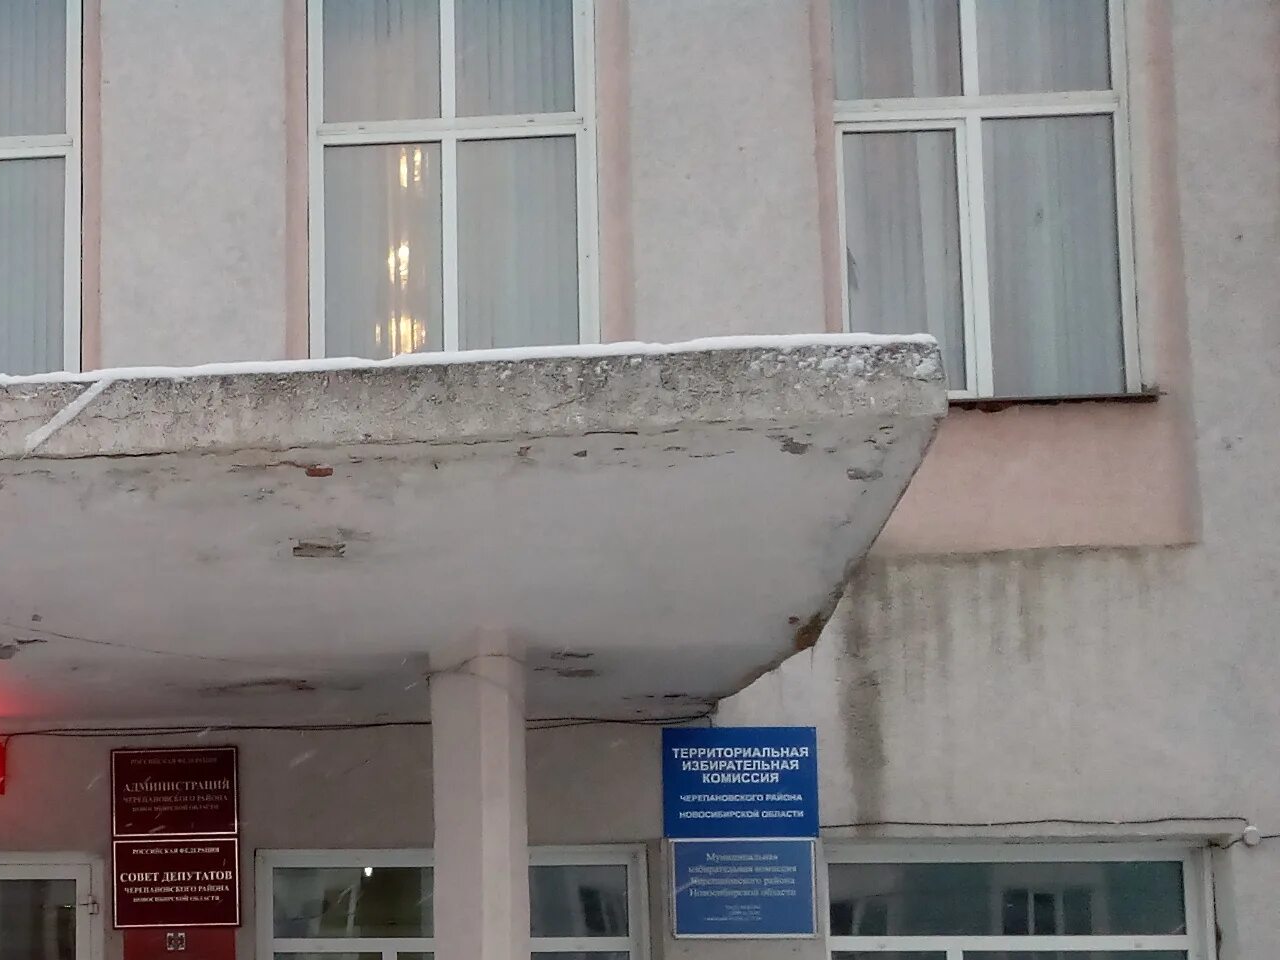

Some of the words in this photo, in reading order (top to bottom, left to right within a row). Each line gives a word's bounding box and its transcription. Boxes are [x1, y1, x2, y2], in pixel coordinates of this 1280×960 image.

[672, 747, 809, 758] ТЕРРИТОРИАЛЬНАЯ
[682, 760, 799, 771] ИЗБИРАТЕЛЬНАЯ
[702, 773, 779, 784] КОМИССИЯ
[123, 780, 230, 792] АДМИНИСТРАЦИЯ
[680, 794, 764, 802] ЧЕРЕПАНОВСКОГО
[765, 793, 803, 801] РАЙОНА
[679, 810, 759, 818] НОВОСИБИРСКОЙ
[762, 810, 804, 818] ОБЛАСТИ
[120, 872, 159, 882] СОВЕТ
[161, 871, 233, 882] ДЕПУТАТОВ
[124, 886, 197, 894] ЧЕРЕПАНОВСКОГО
